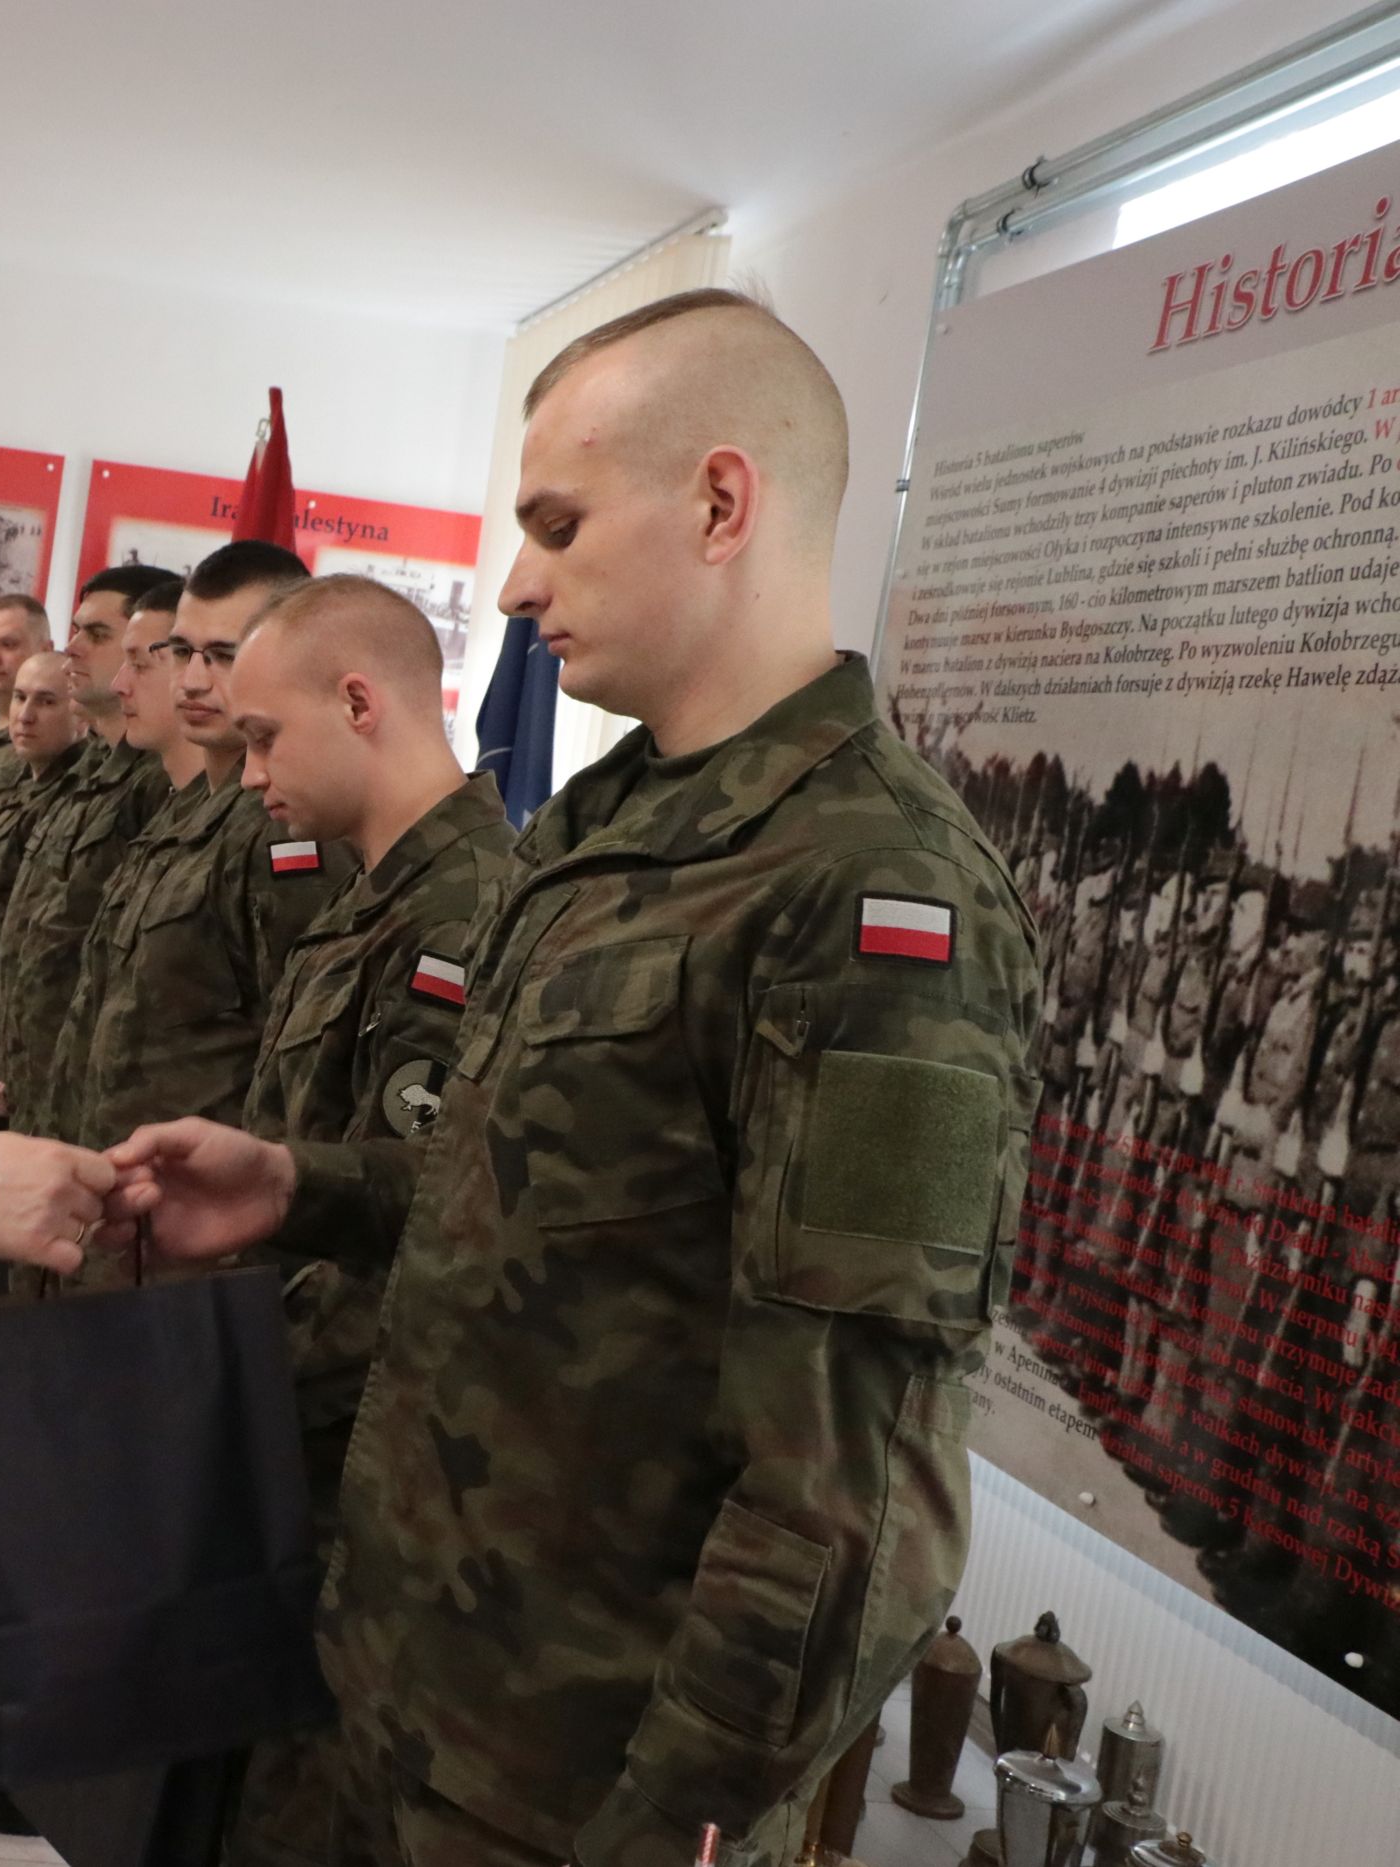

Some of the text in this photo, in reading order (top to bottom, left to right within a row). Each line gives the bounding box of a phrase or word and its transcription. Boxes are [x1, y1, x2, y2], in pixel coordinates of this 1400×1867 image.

[1026, 482, 1096, 511] formowanie
[1109, 467, 1159, 494] dywizji
[1161, 456, 1222, 490] piechoty
[1224, 450, 1248, 471] im.
[1251, 444, 1263, 471] J.
[1268, 428, 1368, 464] Kilińskiego.
[1374, 416, 1397, 441] W
[1050, 446, 1125, 478] wojskowych
[1129, 446, 1145, 461] na
[1148, 424, 1219, 463] podstawie
[1222, 415, 1283, 441] rozkazu
[1287, 393, 1362, 427] dowódcy
[1074, 510, 1099, 529] trzy
[1102, 494, 1165, 525] kompanie
[1169, 484, 1230, 517] saperów
[1231, 478, 1239, 500] i
[1241, 472, 1293, 505] pluton
[1296, 460, 1363, 491] zwiadu.
[1369, 453, 1393, 476] Po
[1089, 526, 1163, 555] rozpoczyna
[1165, 511, 1250, 542] intensywne
[1253, 497, 1334, 528] szkolenie.
[1339, 487, 1375, 515] Pod
[1046, 563, 1095, 585] Lublina,
[1100, 559, 1134, 585] gdzie
[1137, 553, 1156, 578] się
[1158, 547, 1201, 572] szkoli
[1212, 538, 1255, 571] pełni
[1256, 533, 1309, 560] służbę
[1312, 525, 1399, 553] ochronną.
[1058, 590, 1080, 612] 160
[1087, 591, 1106, 609] cio
[1109, 579, 1208, 606] kilometrowym
[1212, 573, 1281, 597] marszem
[1285, 563, 1344, 588] batlion
[1349, 556, 1399, 585] udaje
[1059, 618, 1135, 646] Bydgoszczy.
[1138, 613, 1159, 634] Na
[1160, 606, 1225, 638] początku
[1228, 604, 1279, 632] lutego
[1282, 595, 1350, 628] dywizja
[1085, 652, 1100, 666] na
[1103, 644, 1175, 669] Kołobrzeg.
[1179, 640, 1197, 661] Po
[1200, 633, 1295, 665] wyzwoleniu
[993, 677, 1041, 702] dalszych
[1043, 674, 1112, 697] działaniach
[1115, 672, 1161, 698] forsuje
[1165, 676, 1173, 691] z
[1176, 670, 1234, 697] dywizją
[1238, 667, 1282, 694] rzekę
[1285, 664, 1352, 693] Hawelę
[1343, 1203, 1400, 1247] batali
[1231, 1243, 1346, 1304] październiku
[1191, 1293, 1258, 1343] korpusu
[1263, 1333, 1356, 1390] otrzymuje
[1259, 1286, 1358, 1351] W sierpniu
[1238, 1392, 1339, 1461] stanowiska
[1315, 1385, 1335, 1417] W
[994, 1373, 1046, 1412] ostatnim
[1048, 1403, 1100, 1441] etapem
[1156, 1461, 1223, 1515] saperów
[1226, 1494, 1240, 1523] 5
[1243, 1504, 1329, 1577] Kresowej
[1191, 1408, 1259, 1458] walkach
[1344, 1485, 1367, 1513] na
[1193, 1446, 1206, 1467] w
[1210, 1454, 1281, 1509] grudniu
[1287, 1493, 1320, 1528] nad
[1325, 1514, 1380, 1569] rzeką
